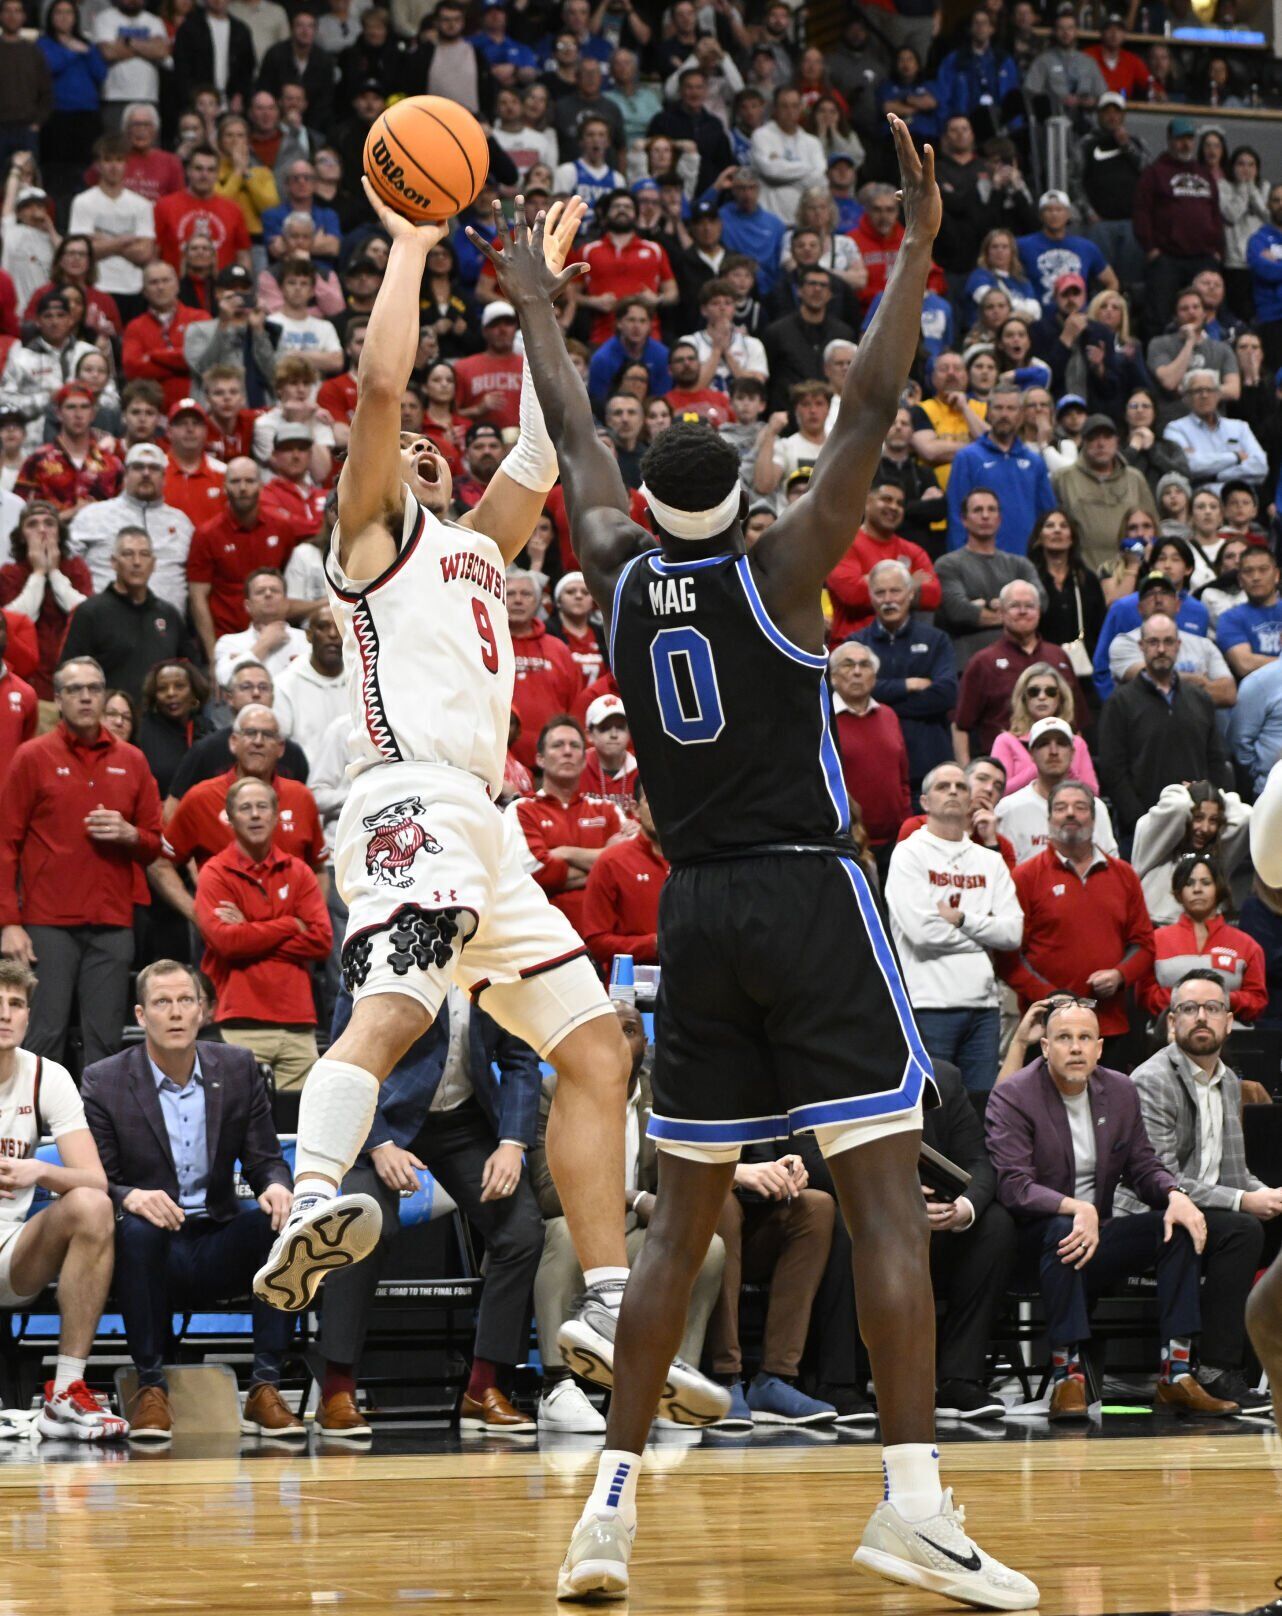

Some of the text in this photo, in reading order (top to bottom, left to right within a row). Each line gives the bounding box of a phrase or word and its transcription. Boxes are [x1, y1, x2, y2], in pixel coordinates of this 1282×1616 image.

[372, 135, 432, 209] Wilson
[471, 371, 523, 396] BUCK
[648, 576, 697, 617] MAG
[471, 596, 499, 675] 9
[649, 625, 727, 746] 0
[393, 827, 416, 854] W
[389, 1287, 409, 1297] ROAD
[408, 1287, 420, 1296] TO
[419, 1287, 433, 1296] THE
[433, 1287, 453, 1296] FINAL
[453, 1286, 473, 1296] FOUR
